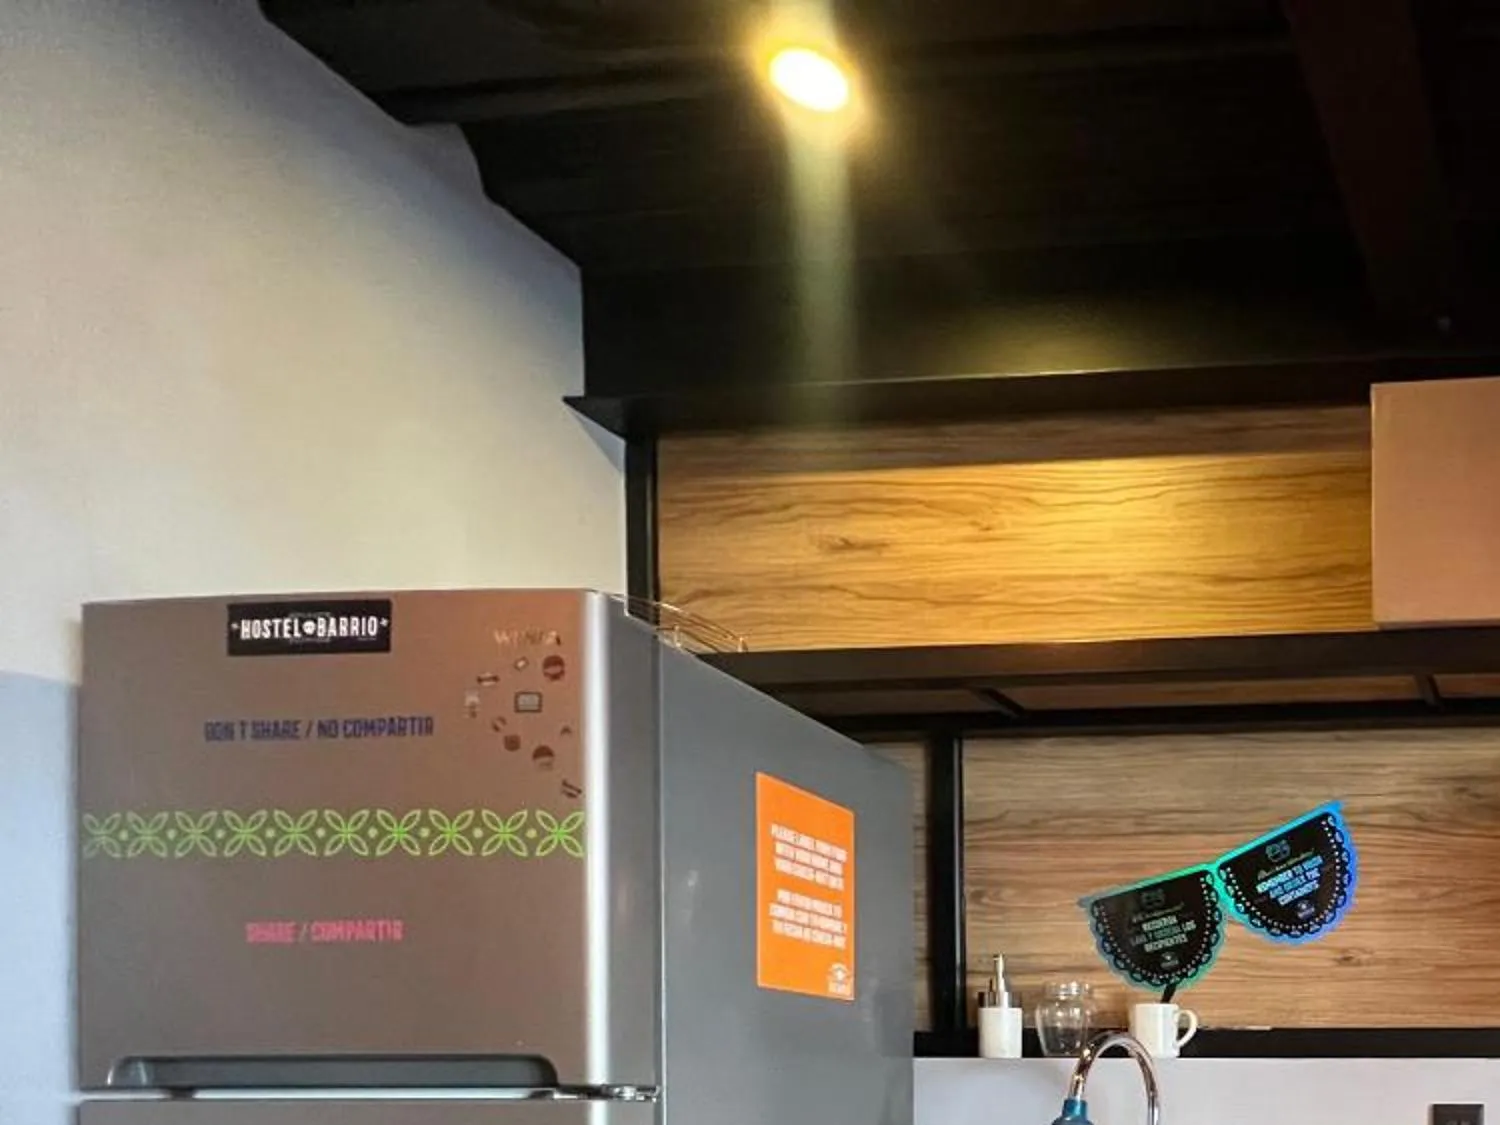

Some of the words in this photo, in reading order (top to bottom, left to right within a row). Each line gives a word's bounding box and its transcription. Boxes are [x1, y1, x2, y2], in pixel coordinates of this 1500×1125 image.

[240, 618, 301, 639] HOSTEL
[317, 616, 378, 637] BARRIO
[250, 719, 302, 741] SHARE
[317, 719, 340, 739] NO
[342, 716, 434, 738] COMPARTIR
